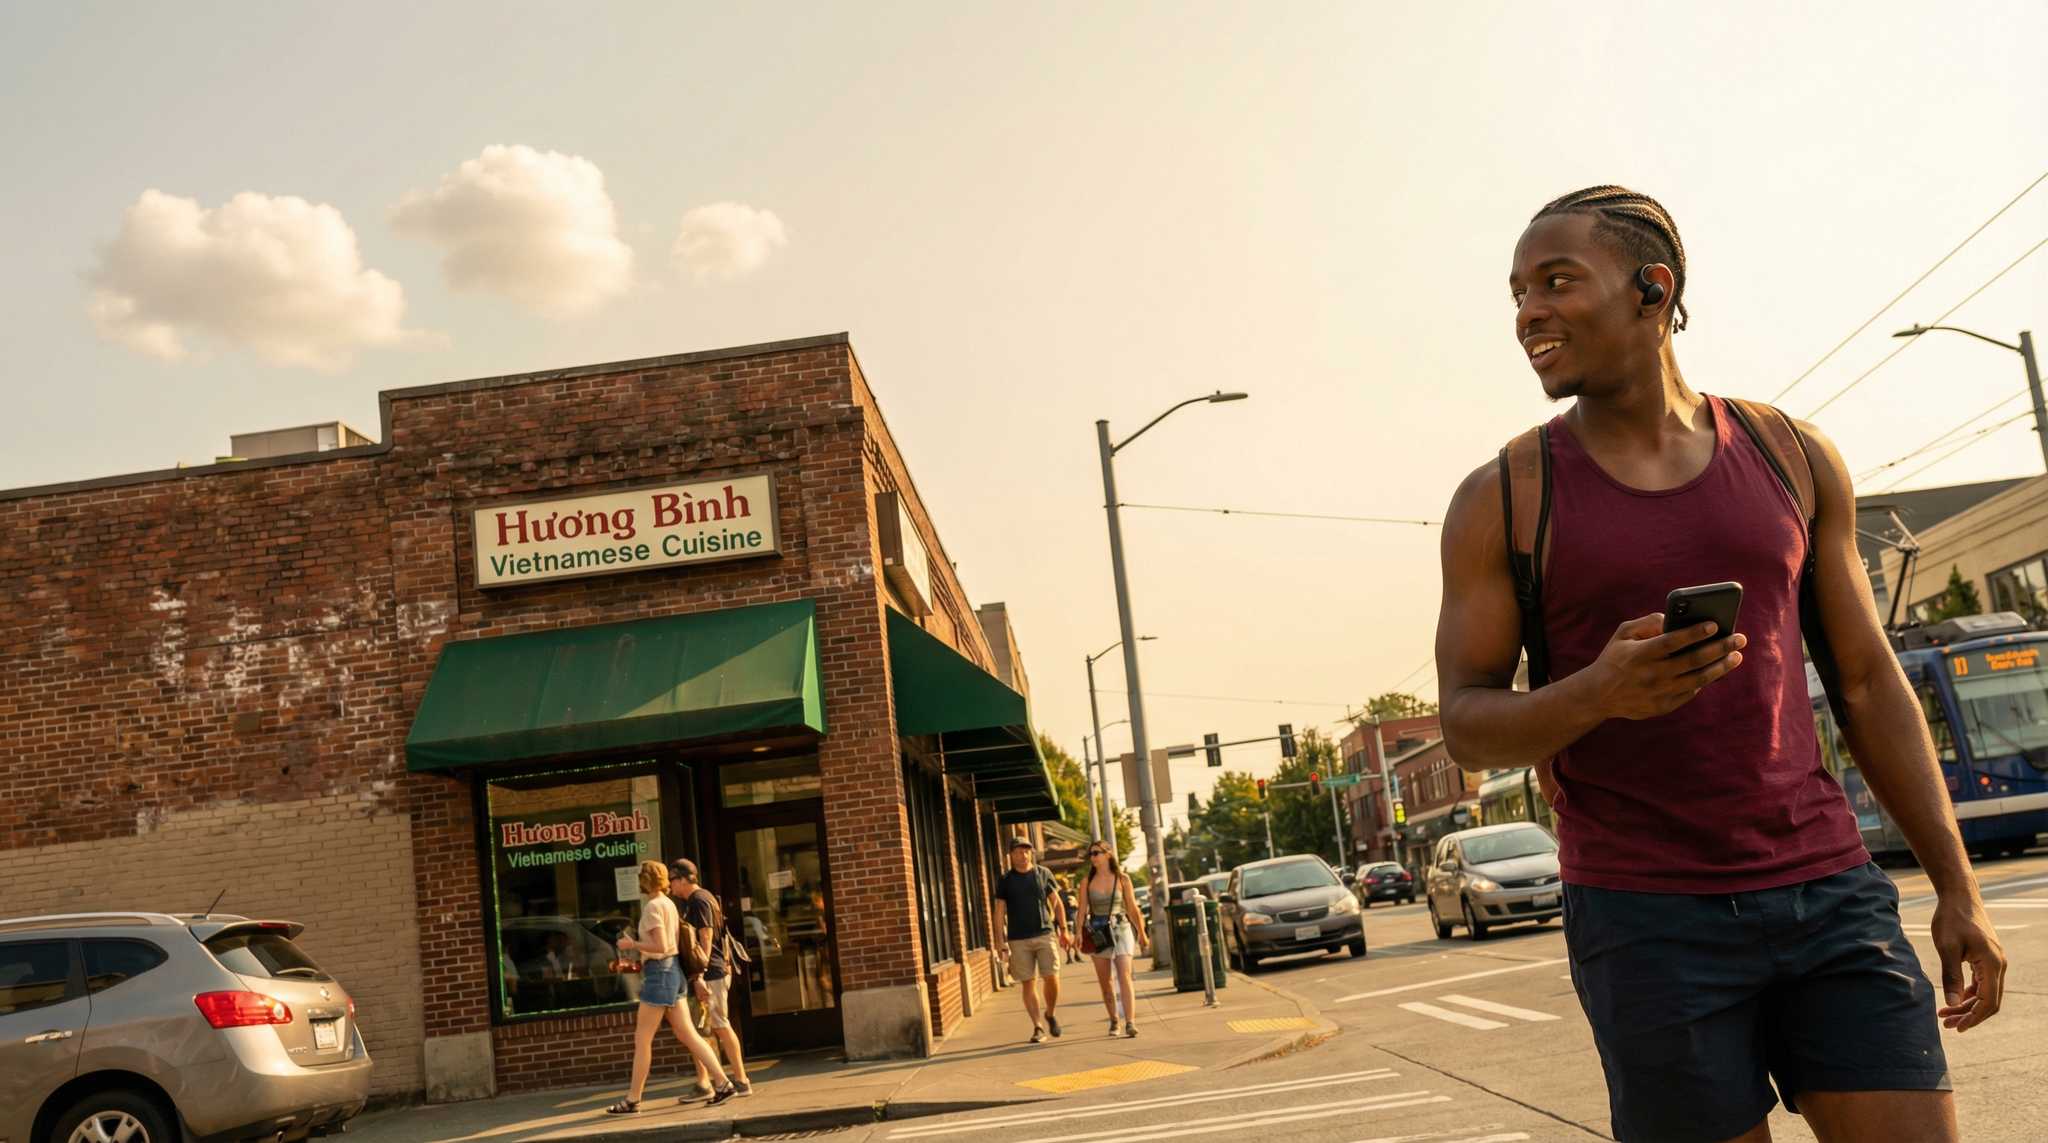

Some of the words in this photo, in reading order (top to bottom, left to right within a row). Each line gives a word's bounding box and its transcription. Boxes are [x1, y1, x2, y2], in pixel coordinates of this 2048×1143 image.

[496, 508, 636, 546] Hương
[651, 485, 751, 529] Bình
[490, 544, 650, 577] Vietnamese
[662, 528, 762, 558] Cuisine
[590, 808, 651, 838] Bình
[507, 848, 591, 868] Vietnamese
[595, 840, 647, 858] Cuisine
